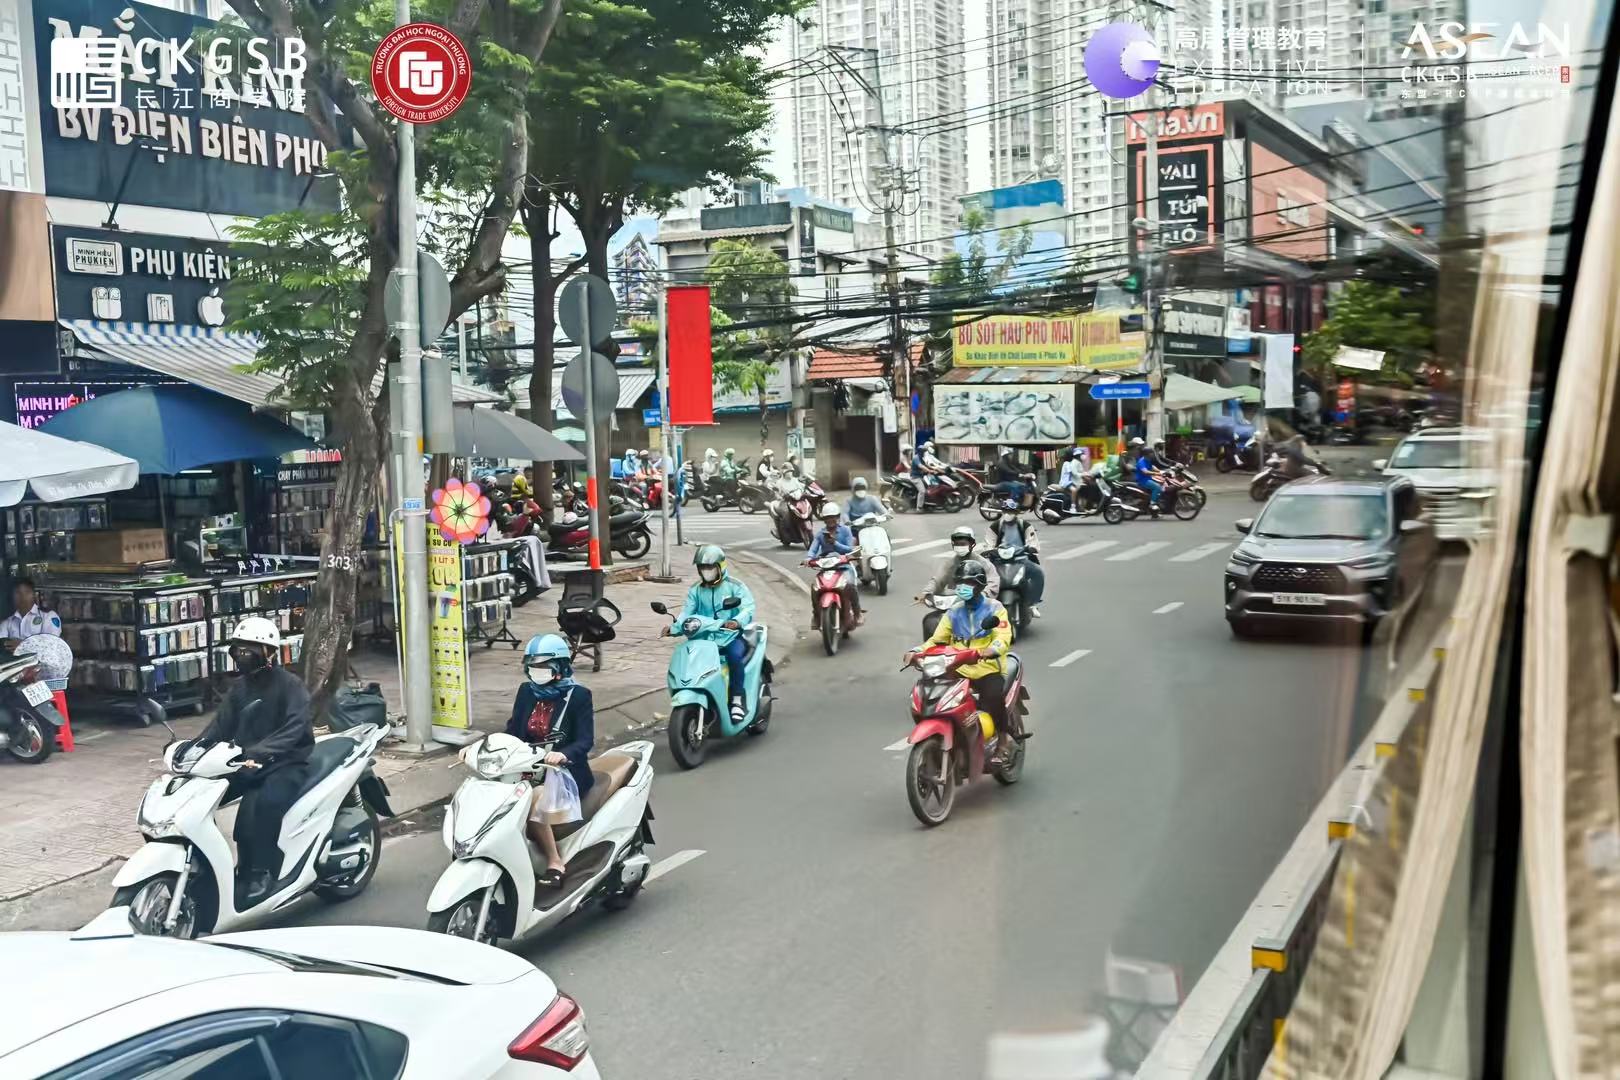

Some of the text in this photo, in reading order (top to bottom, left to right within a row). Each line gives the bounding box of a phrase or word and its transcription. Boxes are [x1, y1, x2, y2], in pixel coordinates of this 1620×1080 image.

[200, 115, 268, 167] BIÊN
[131, 247, 176, 280] PHỤ
[183, 248, 231, 283] KIỆN
[19, 397, 53, 411] MINH
[327, 553, 351, 570] 303
